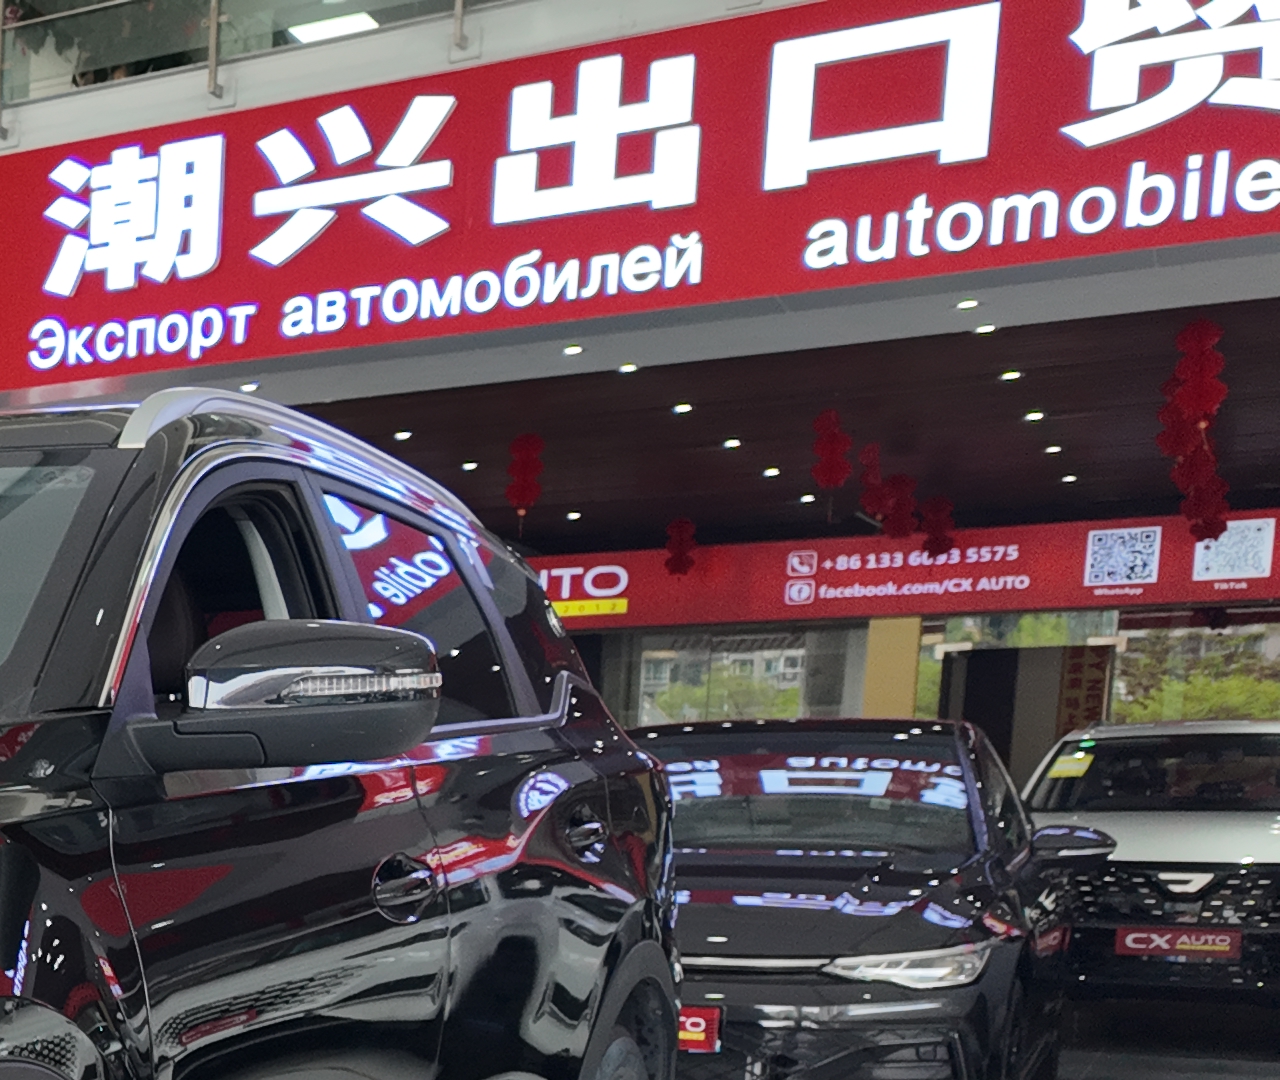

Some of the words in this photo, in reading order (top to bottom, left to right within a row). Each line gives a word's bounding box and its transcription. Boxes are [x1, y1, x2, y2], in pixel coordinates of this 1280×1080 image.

[802, 149, 1280, 270] automobile
[27, 301, 257, 371] Экспорт
[281, 231, 704, 339] автомобилей
[821, 553, 862, 571] +86
[866, 552, 904, 568] 133
[965, 544, 1020, 563] 5575
[818, 577, 974, 599] facebook.com/CX
[975, 574, 1031, 592] AUTO
[1125, 933, 1172, 949] CX
[1175, 934, 1231, 946] AUTO
